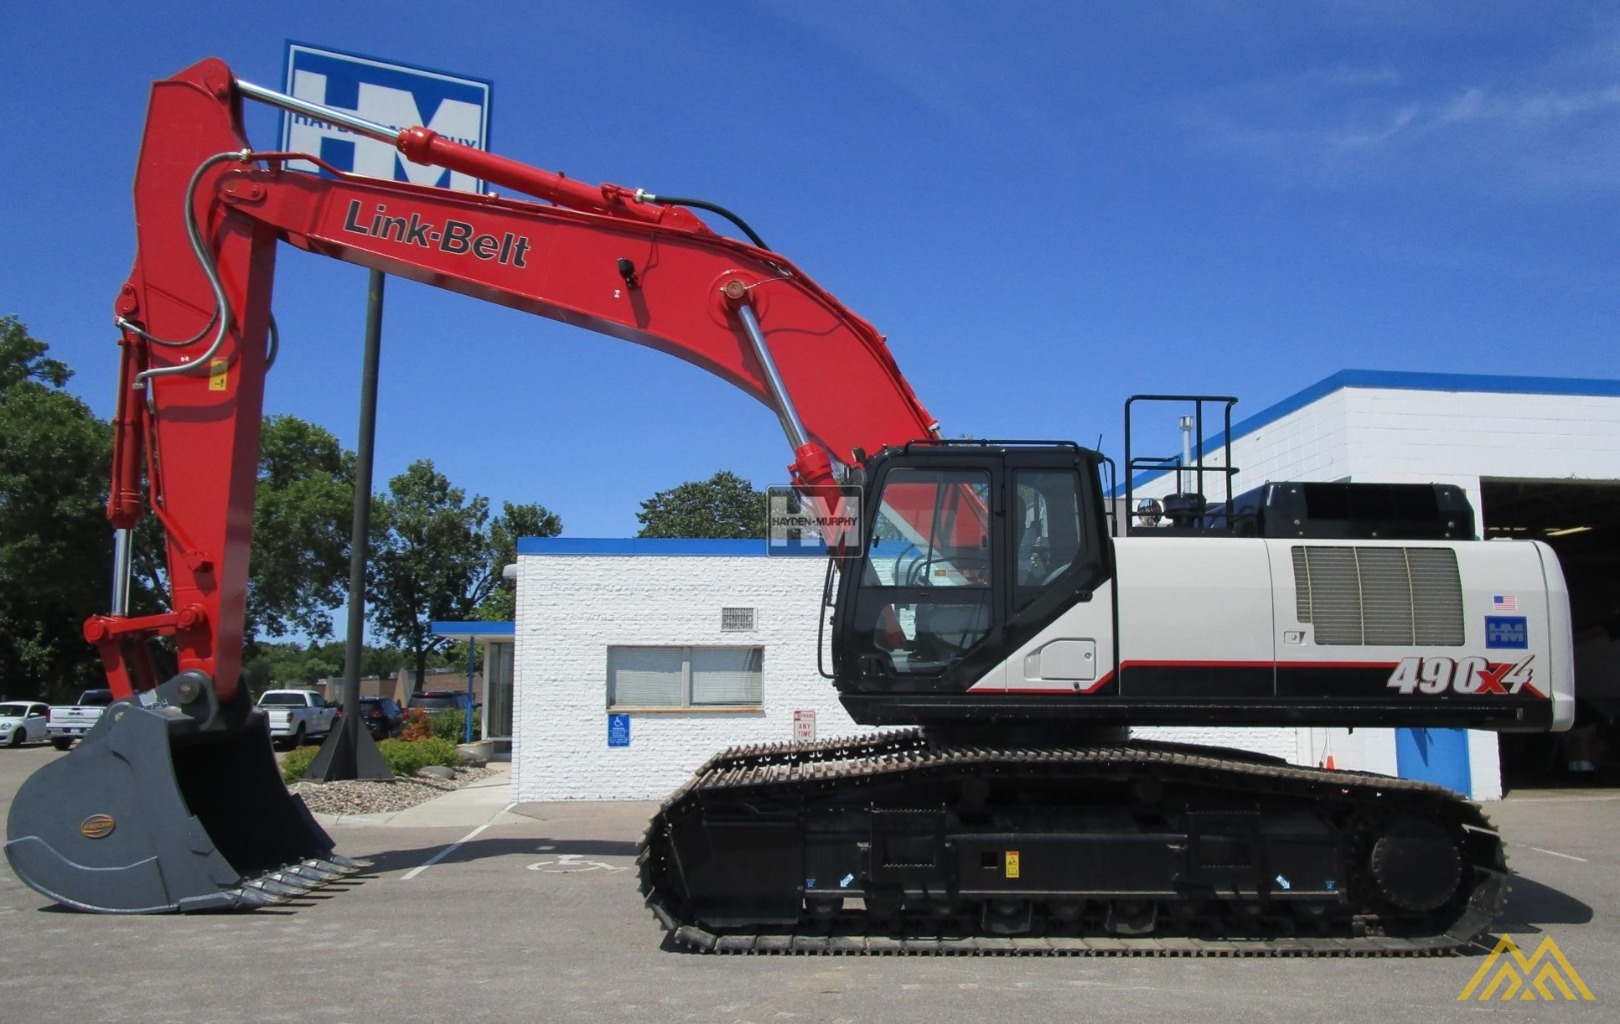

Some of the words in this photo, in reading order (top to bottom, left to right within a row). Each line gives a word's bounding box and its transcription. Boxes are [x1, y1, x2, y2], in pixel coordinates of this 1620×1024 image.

[285, 69, 482, 193] HM
[343, 200, 531, 268] Link-Belt
[1489, 623, 1524, 642] HM
